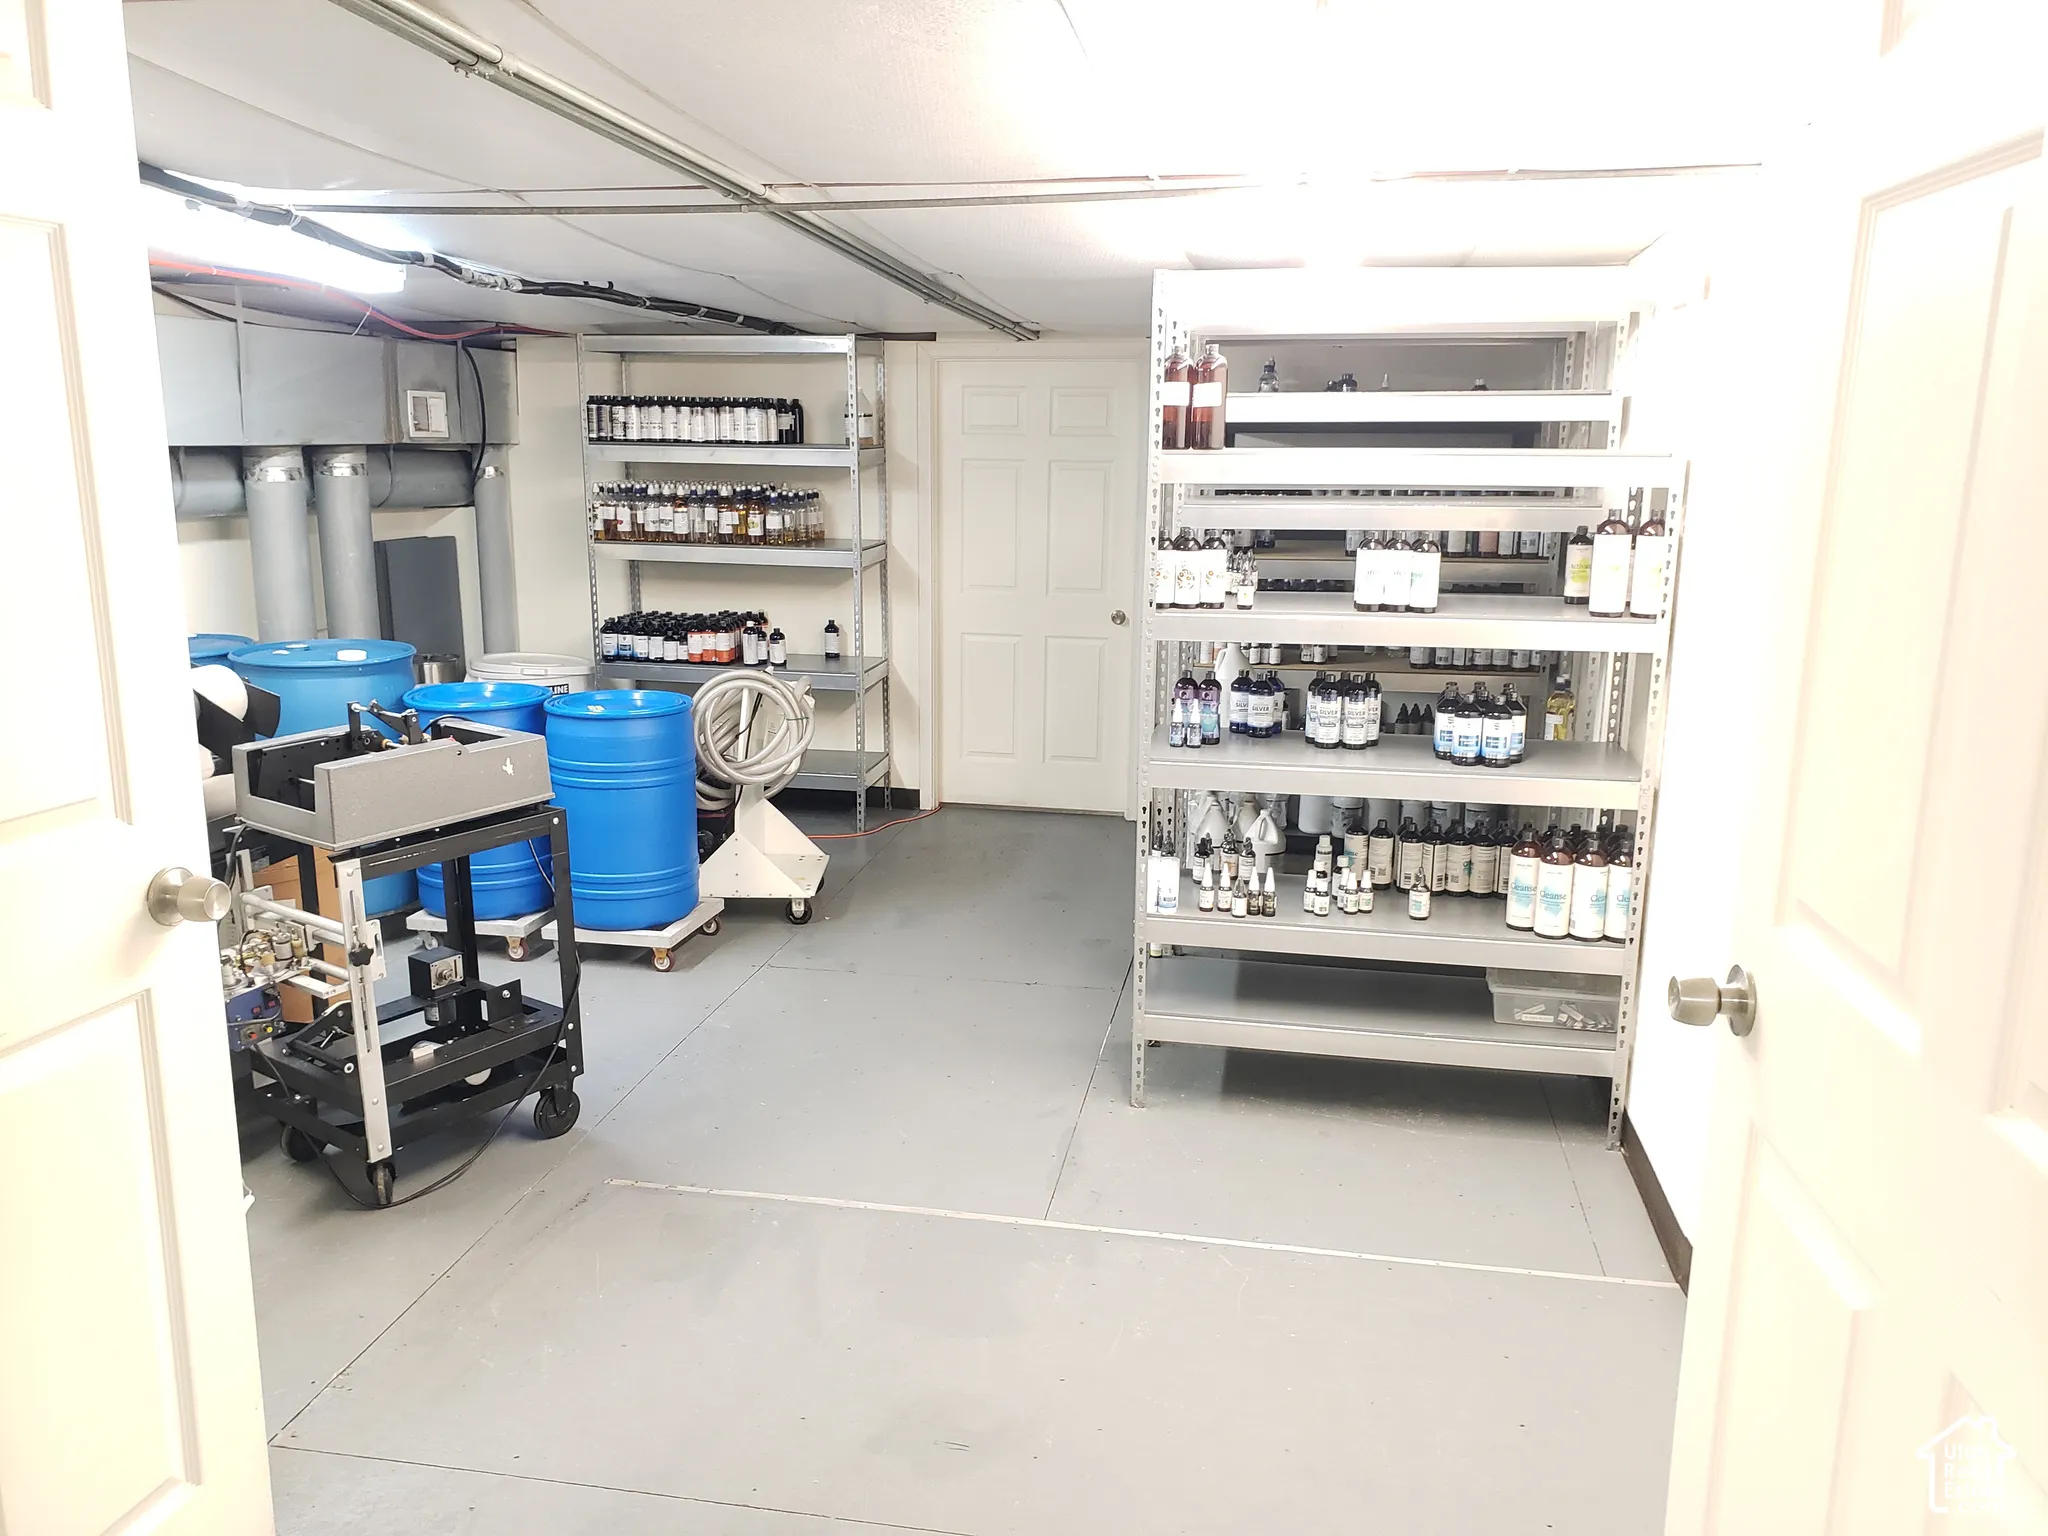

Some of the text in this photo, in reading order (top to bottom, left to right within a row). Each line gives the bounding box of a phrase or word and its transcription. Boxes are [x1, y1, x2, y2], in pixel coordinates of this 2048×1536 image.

[550, 685, 569, 695] LINE
[1510, 882, 1537, 892] Cleanse
[1539, 890, 1567, 900] Cleanse
